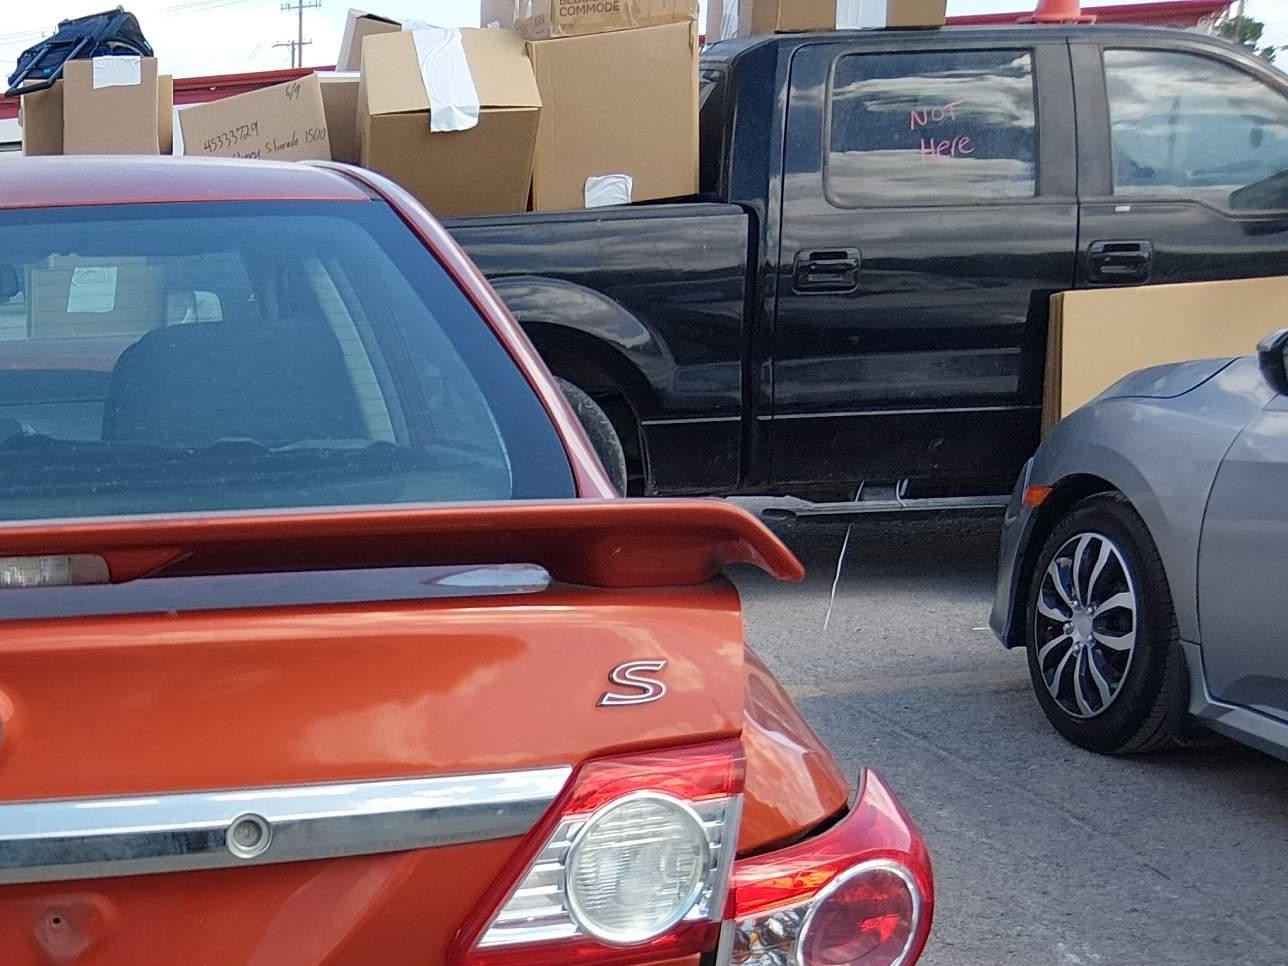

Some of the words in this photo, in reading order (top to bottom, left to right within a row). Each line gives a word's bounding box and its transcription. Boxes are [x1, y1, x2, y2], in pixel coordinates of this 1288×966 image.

[560, 0, 620, 17] COMMODE
[910, 98, 968, 130] NOT
[920, 136, 976, 159] Here
[595, 659, 667, 707] S
